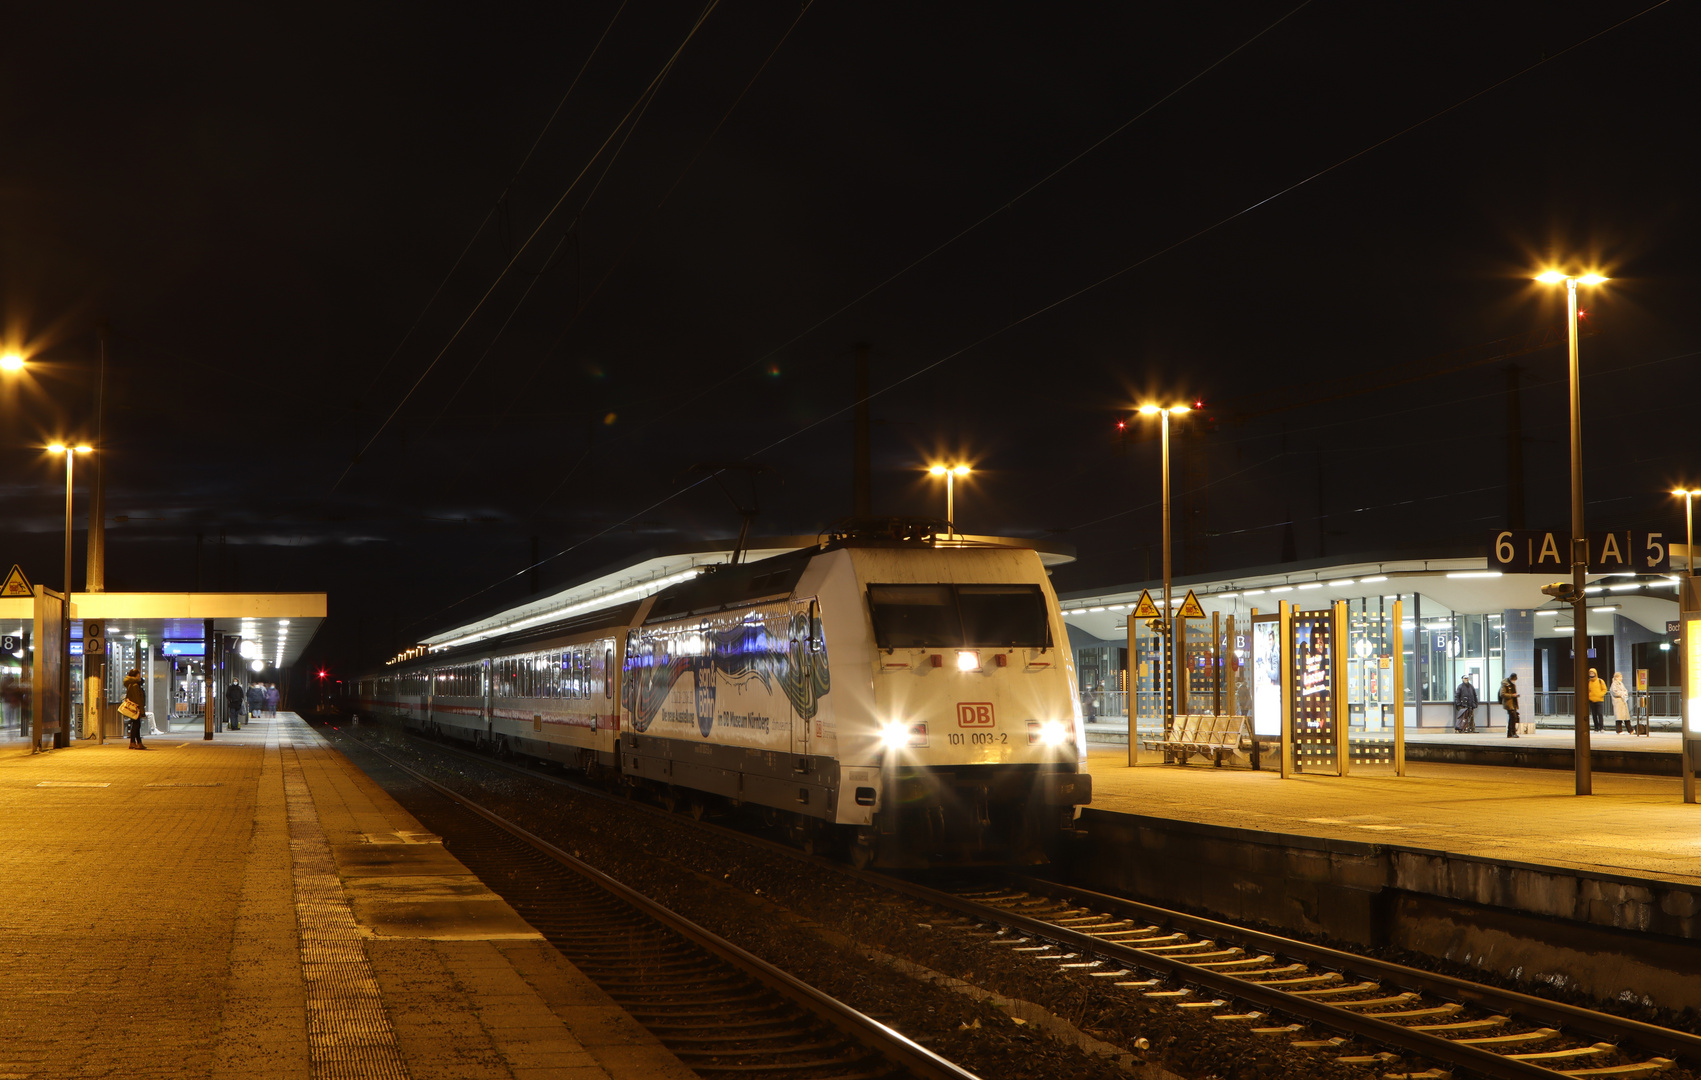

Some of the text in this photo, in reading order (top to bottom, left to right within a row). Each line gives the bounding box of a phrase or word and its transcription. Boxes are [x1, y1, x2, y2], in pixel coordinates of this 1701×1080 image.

[1495, 531, 1561, 564] 6 A
[1600, 532, 1664, 565] A 5
[4, 636, 14, 650] 8
[230, 636, 240, 650] 7
[1236, 635, 1246, 648] B
[1437, 636, 1446, 648] B
[717, 709, 723, 727] im
[723, 711, 730, 727] DB
[730, 711, 748, 729] Museum
[748, 711, 770, 735] Nürnberg
[962, 706, 991, 724] DB
[947, 732, 1008, 745] 101 003-2
